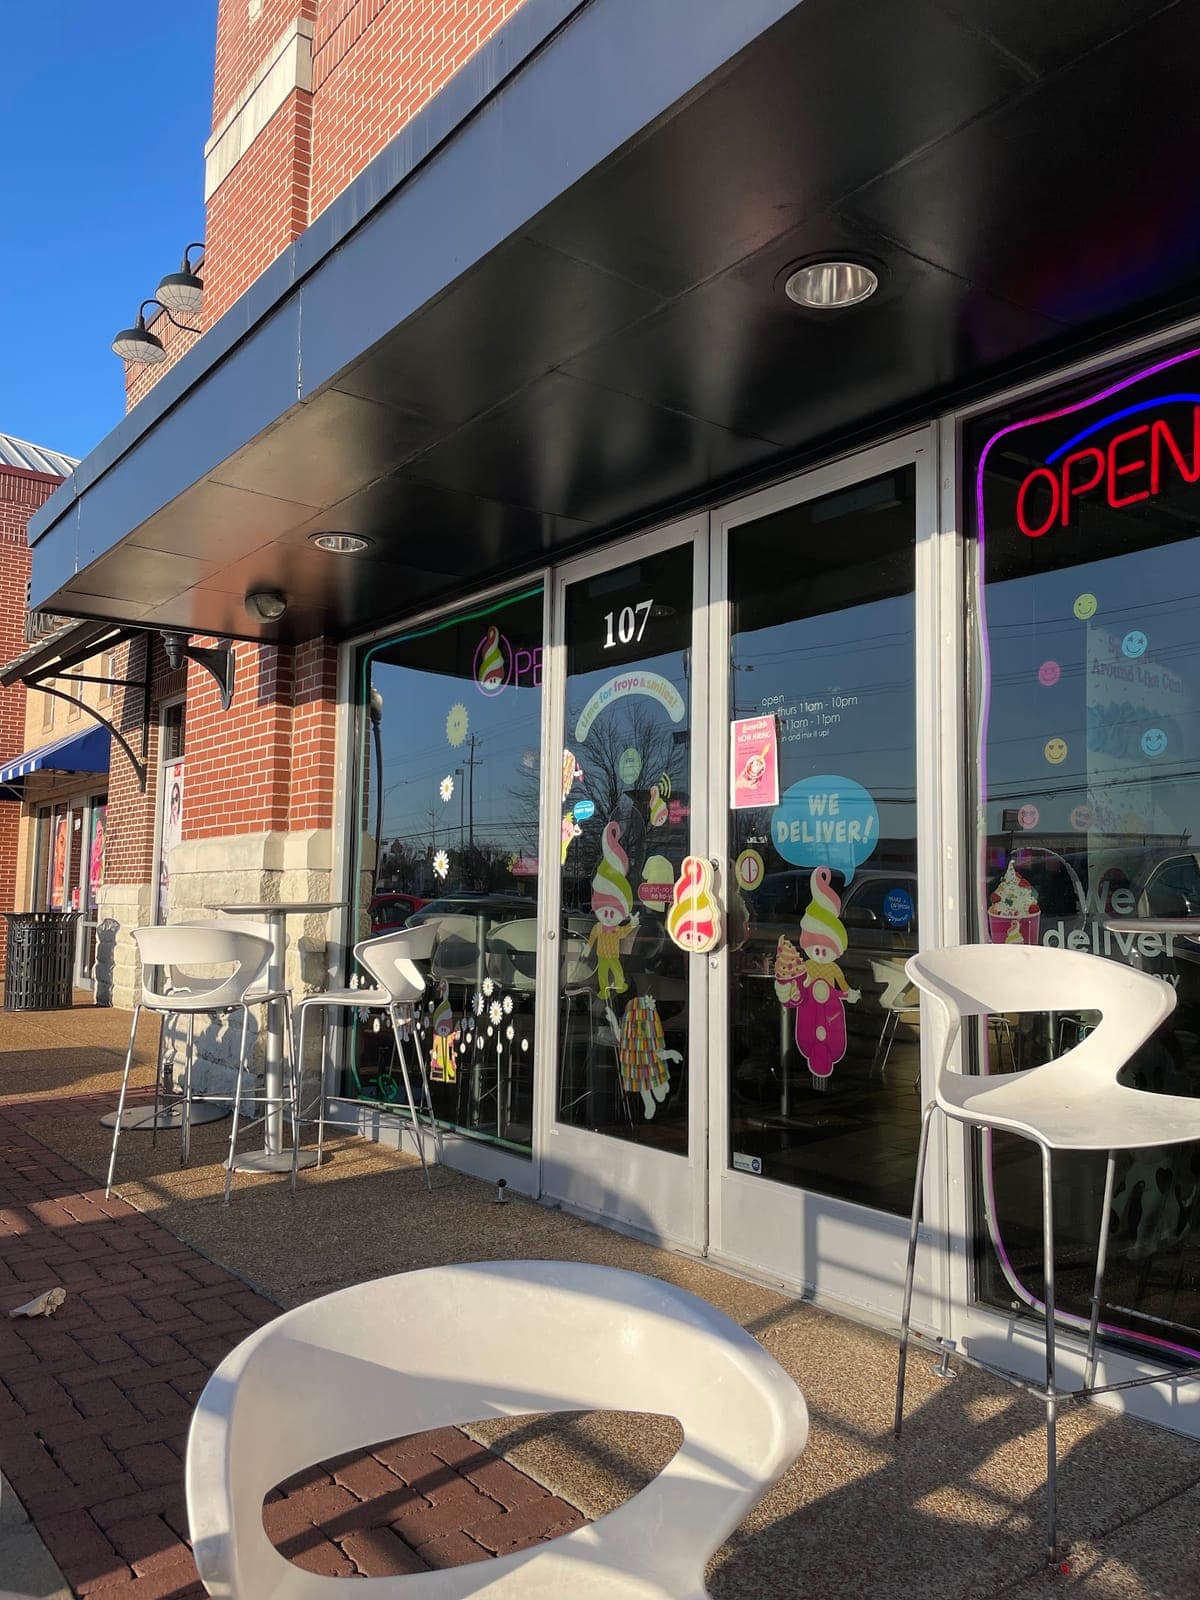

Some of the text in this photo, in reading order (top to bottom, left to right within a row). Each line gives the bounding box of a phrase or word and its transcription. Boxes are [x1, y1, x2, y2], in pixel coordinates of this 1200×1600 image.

[1016, 404, 1200, 538] OPEN
[603, 599, 654, 649] 107
[600, 688, 613, 704] for
[613, 678, 639, 693] froyo
[761, 694, 785, 708] open
[800, 701, 824, 713] 11am
[831, 696, 858, 709] 10pm
[786, 718, 809, 730] 11am
[817, 713, 841, 726] 11pm
[788, 733, 801, 742] and
[808, 792, 840, 817] WE
[776, 815, 874, 844] DELIVER!
[1075, 880, 1136, 914] We
[1042, 920, 1178, 958] deliver
